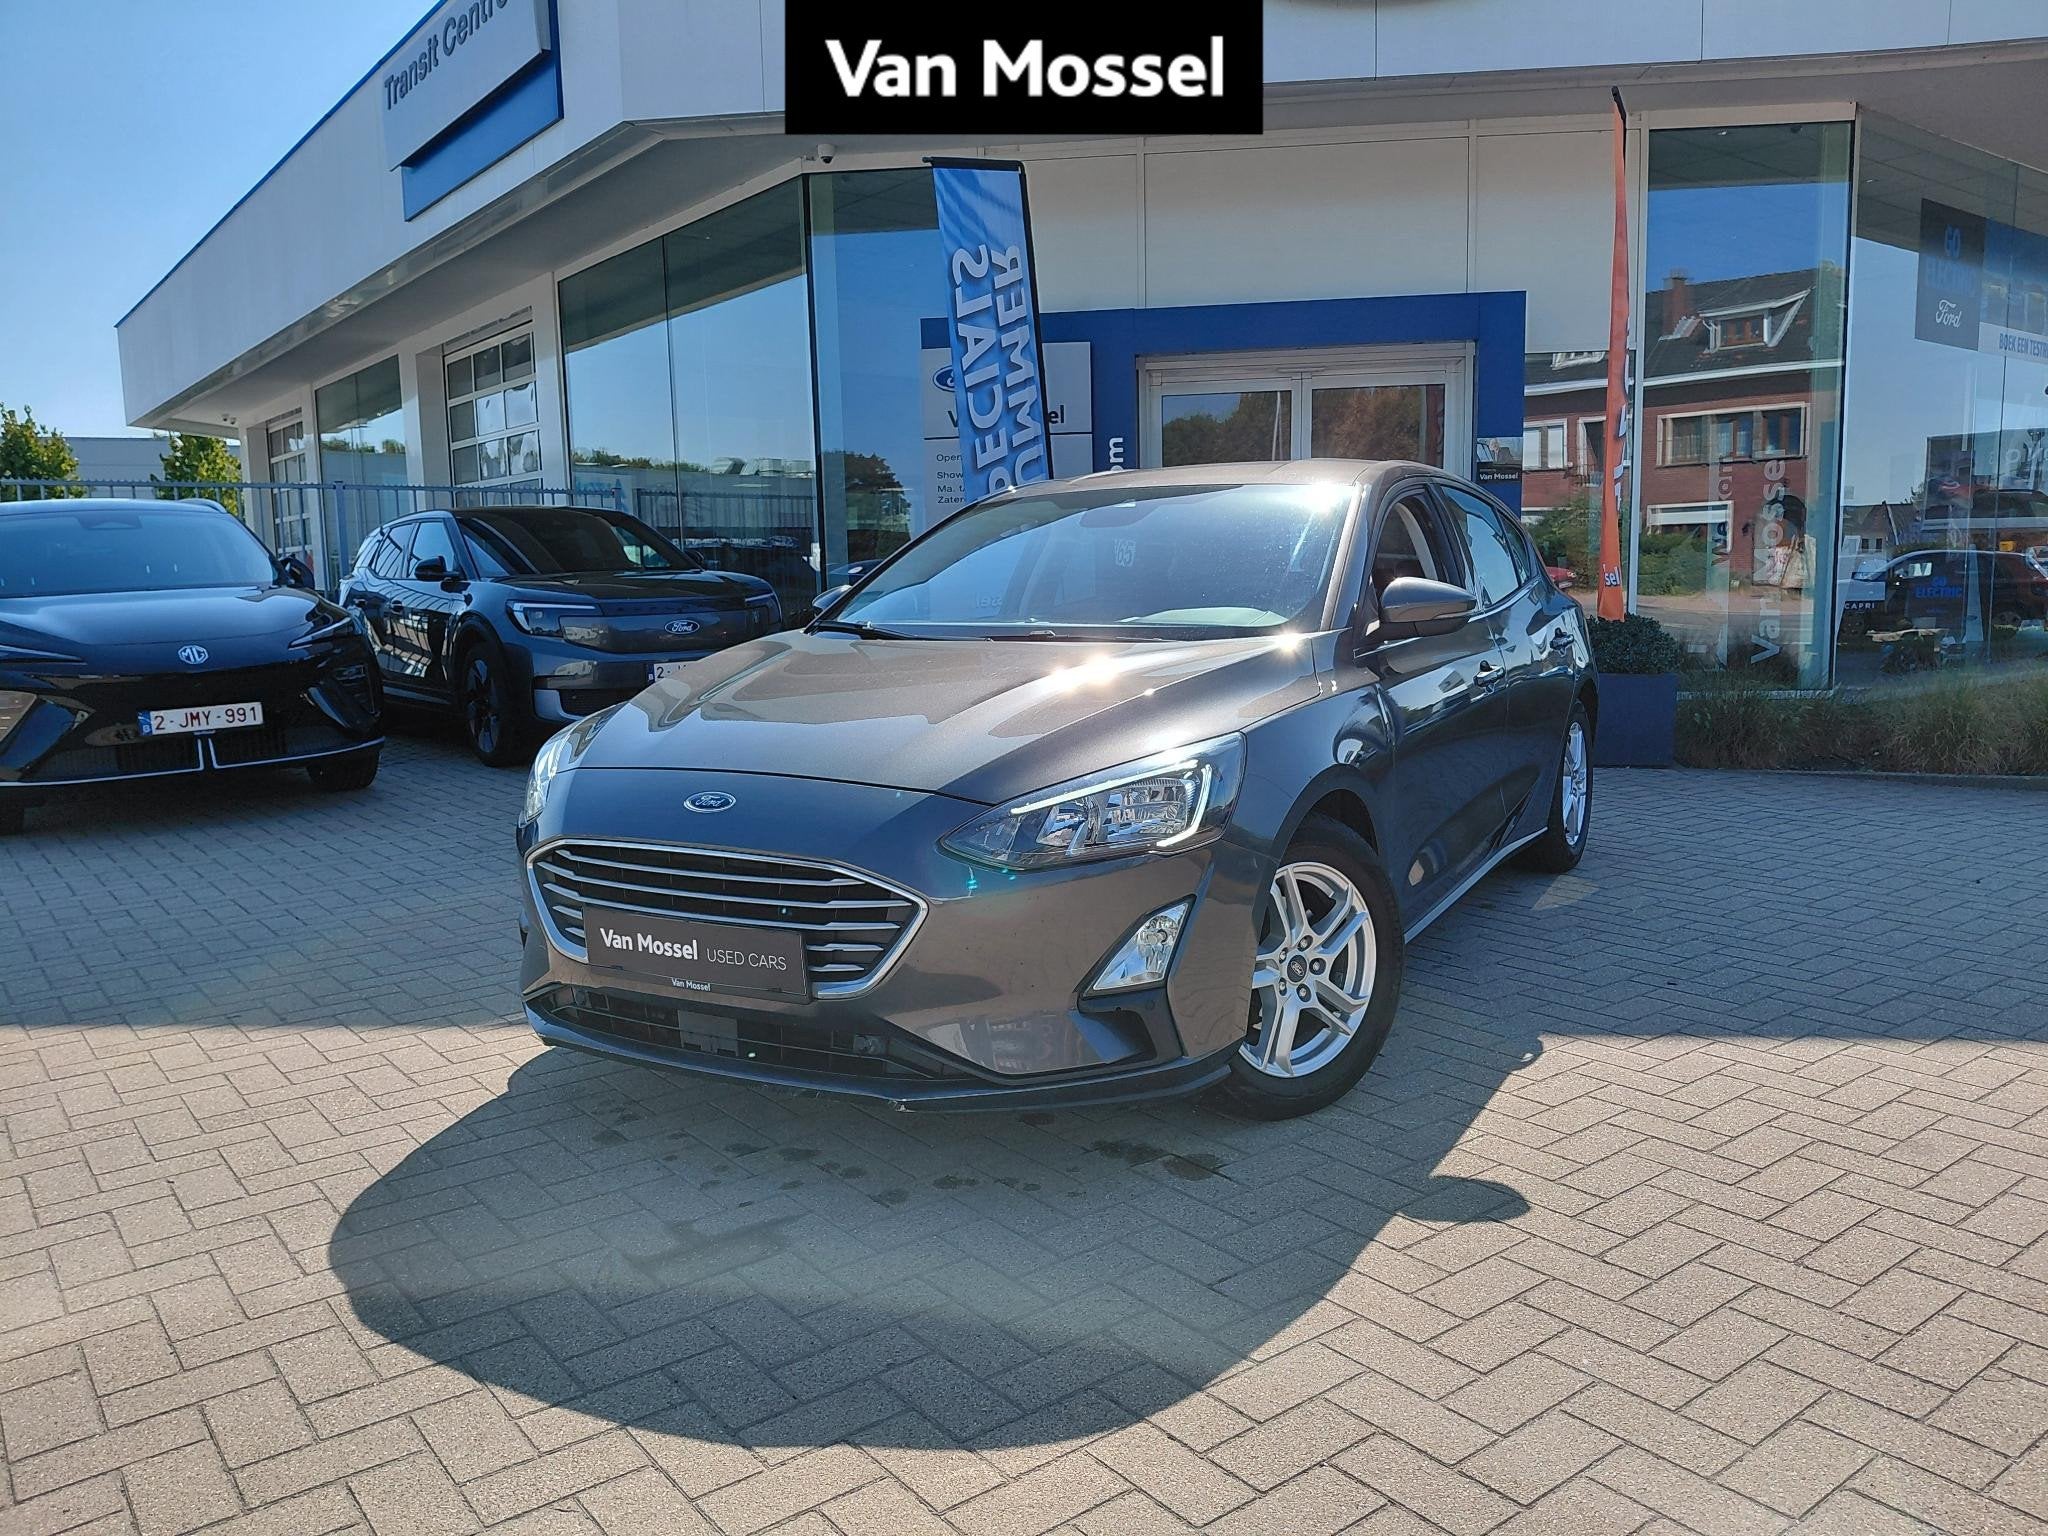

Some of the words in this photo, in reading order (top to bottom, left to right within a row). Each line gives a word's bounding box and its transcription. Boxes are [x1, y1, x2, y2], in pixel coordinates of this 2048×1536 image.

[384, 34, 439, 110] Transit
[1935, 299, 1962, 328] Ford
[1999, 333, 2016, 351] BOEK
[1494, 472, 1519, 480] Mossel
[670, 621, 694, 633] Ford
[1751, 596, 1781, 665] Van
[180, 646, 207, 663] MG
[600, 927, 633, 951] Van
[637, 933, 698, 960] Mossel
[706, 948, 745, 966] USED
[748, 953, 787, 971] CARS
[671, 977, 684, 988] Van
[686, 980, 711, 992] Mossel
